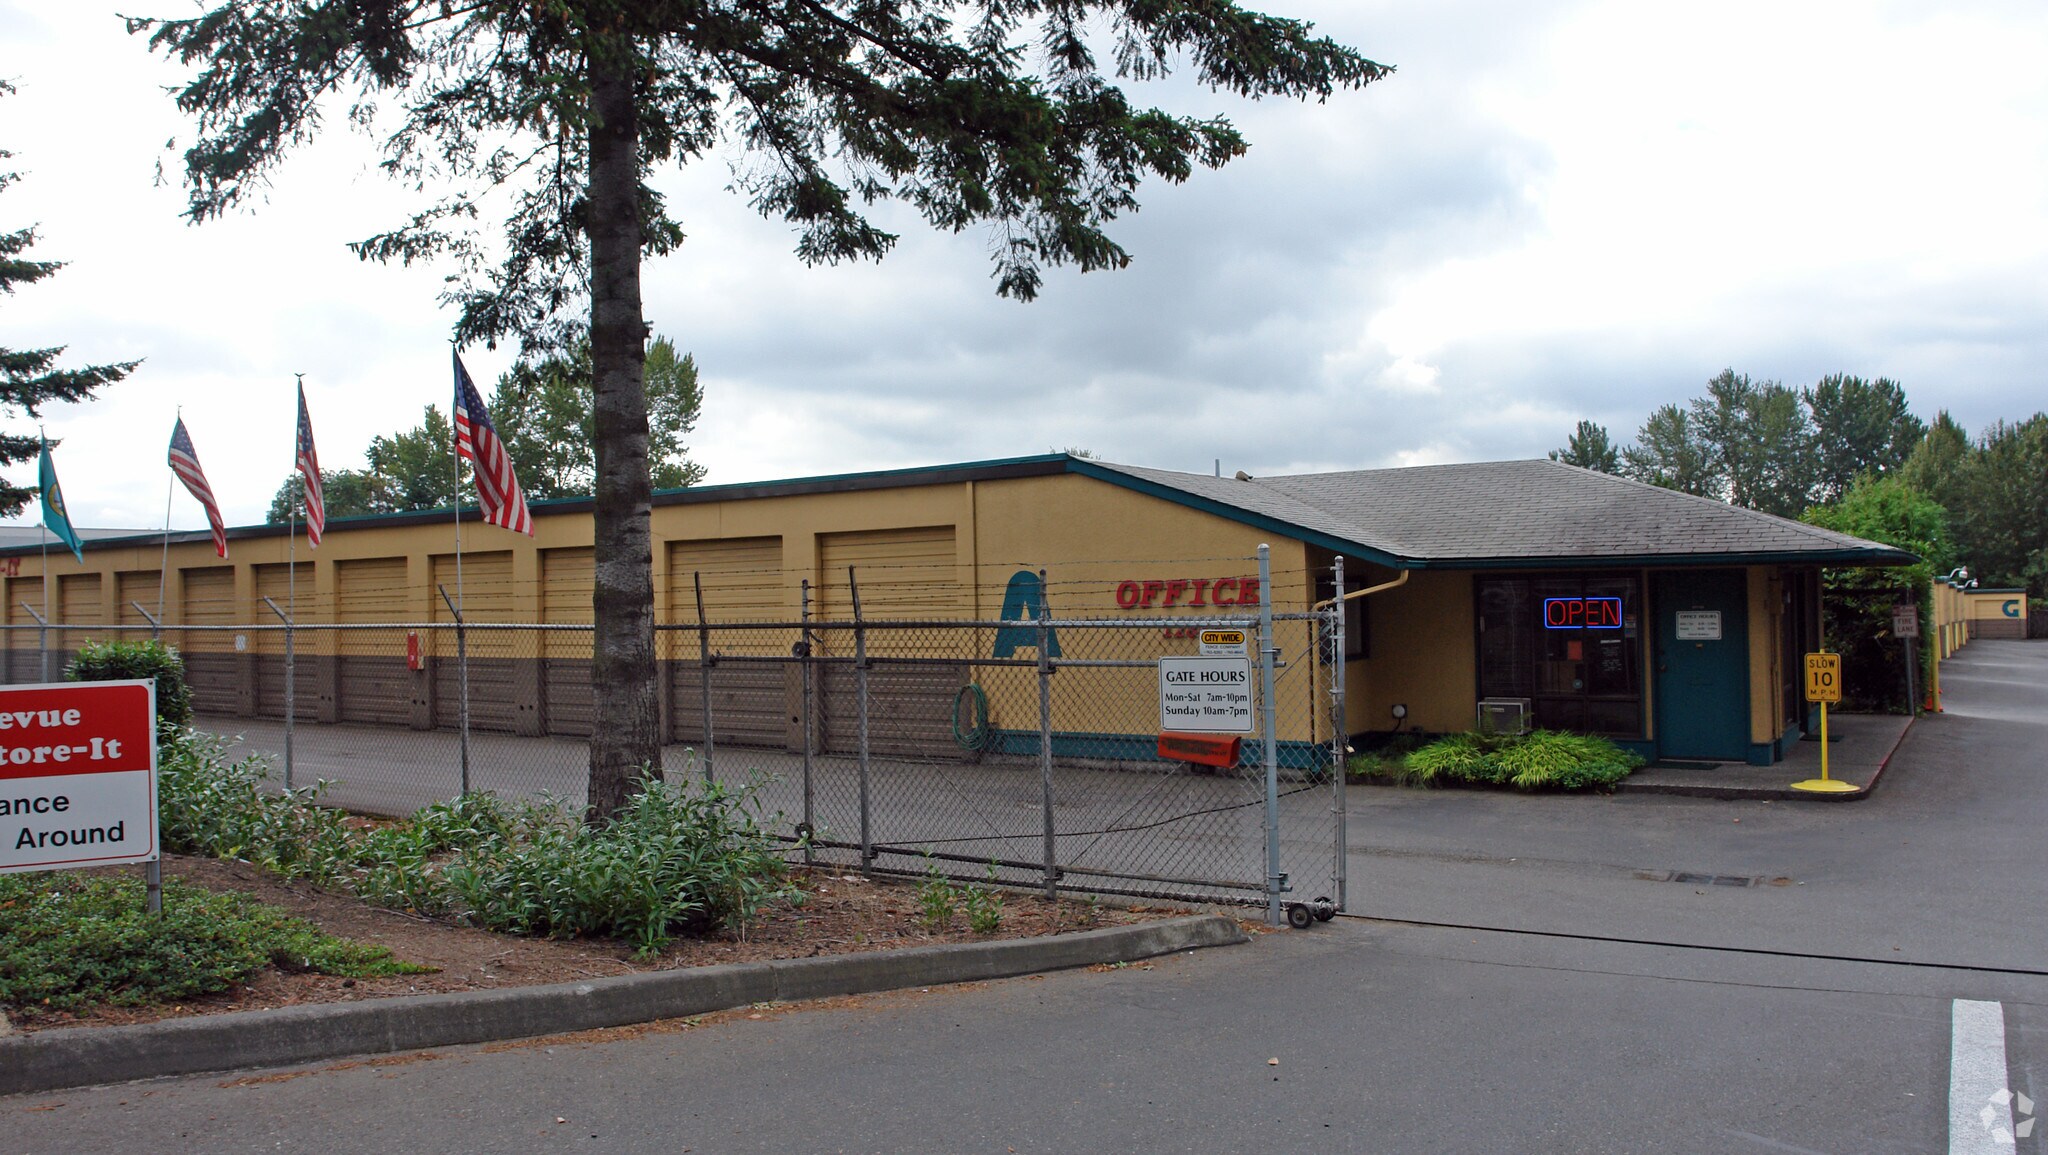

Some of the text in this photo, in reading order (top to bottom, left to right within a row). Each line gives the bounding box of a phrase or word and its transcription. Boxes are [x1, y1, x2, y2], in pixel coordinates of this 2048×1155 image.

[1116, 578, 1260, 609] OFFICE
[992, 570, 1062, 658] A
[1547, 600, 1619, 625] OPEN
[2002, 600, 2019, 617] G
[1204, 633, 1219, 642] CITY
[1221, 633, 1240, 642] WIDE
[1809, 659, 1835, 668] SLOW
[1166, 671, 1245, 682] GATE HOURS
[1813, 672, 1832, 686] 10
[1165, 693, 1247, 704] Mon-Sat 7am-10pm
[1165, 706, 1248, 717] Sunday 10am-7pm
[15, 820, 124, 850] Around
